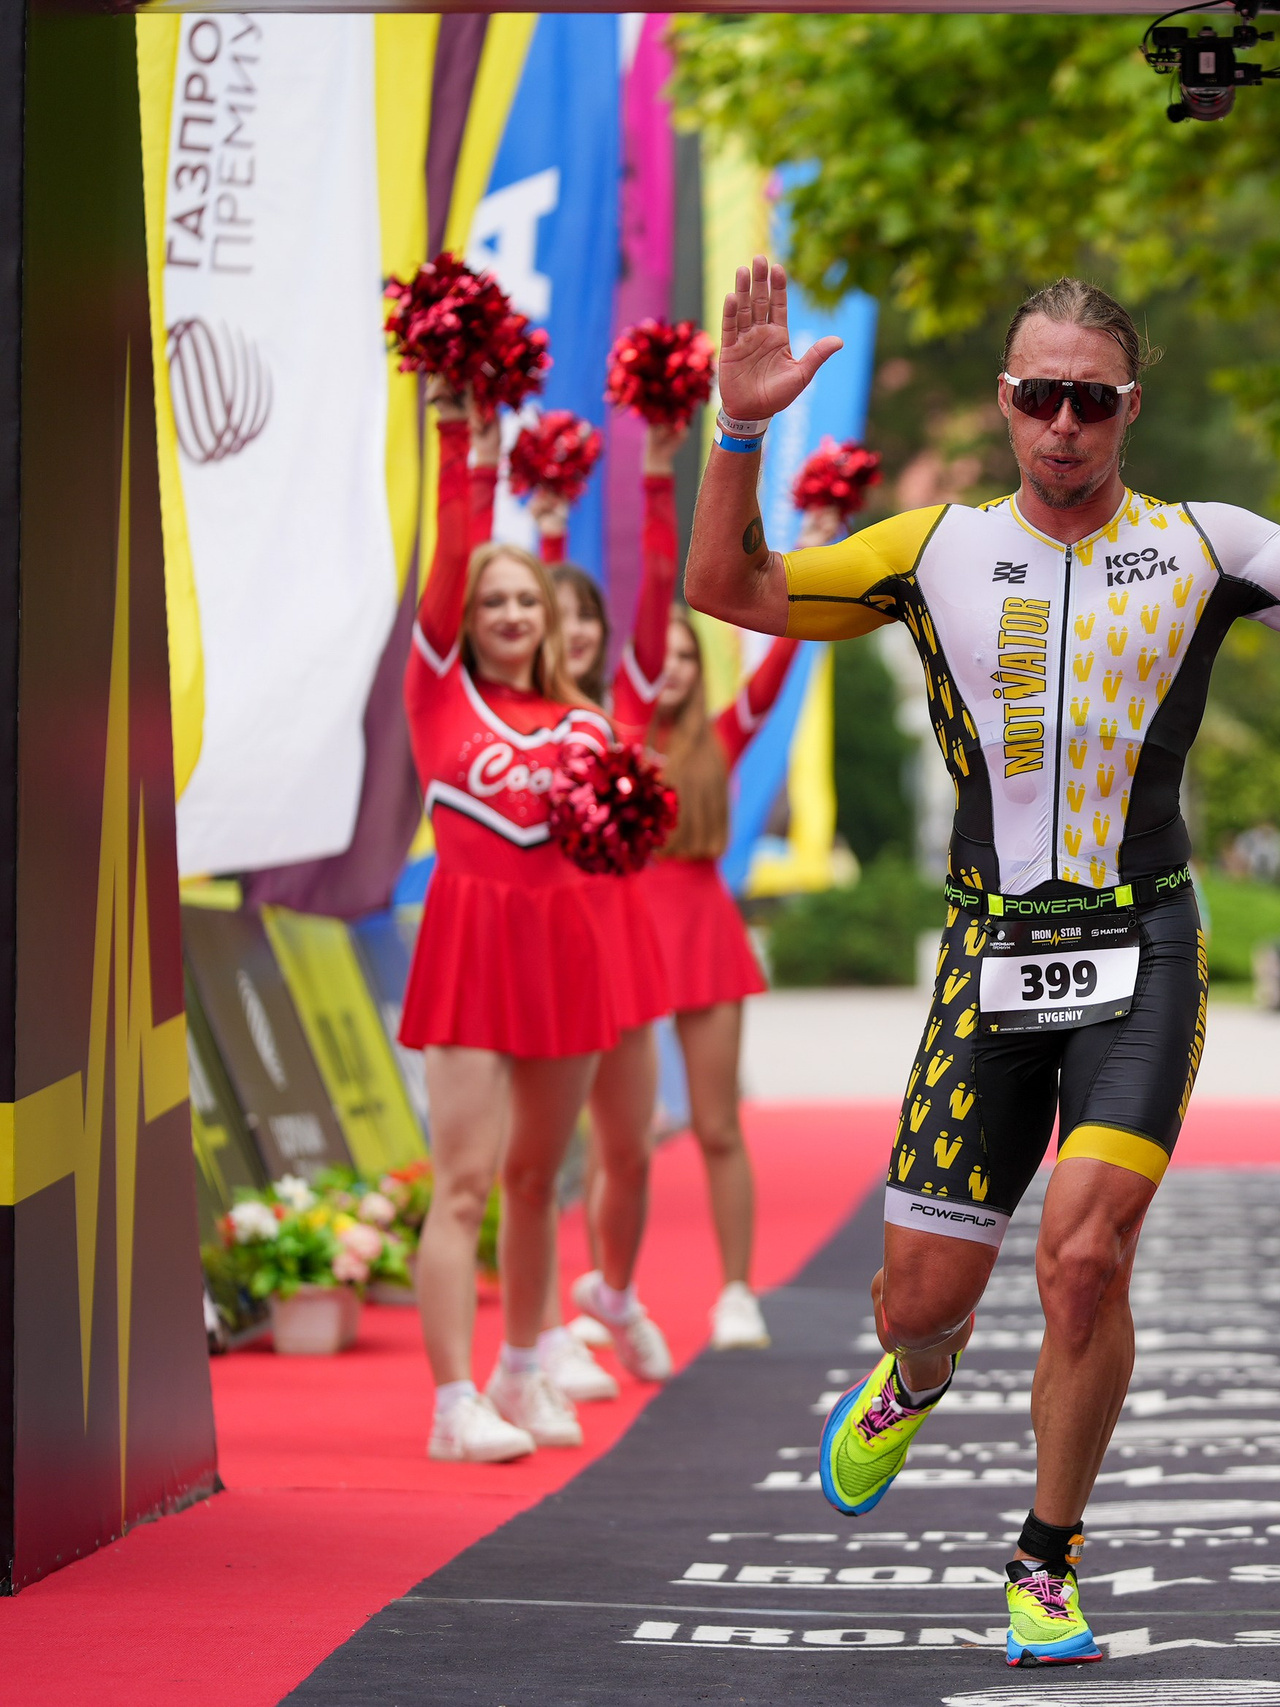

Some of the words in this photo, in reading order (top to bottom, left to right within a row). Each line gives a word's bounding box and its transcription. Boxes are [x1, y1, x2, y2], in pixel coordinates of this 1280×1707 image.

[1105, 547, 1159, 570] KOO
[1107, 555, 1180, 587] KASK
[467, 741, 554, 798] Coo
[1005, 892, 1115, 915] POWERUP
[1031, 929, 1052, 941] IRON
[1060, 926, 1082, 939] STAR
[1100, 927, 1129, 936] МАГНИТ
[1020, 959, 1098, 1001] 399
[1037, 1009, 1084, 1024] EVGENIY
[910, 1202, 997, 1228] POWERUP
[682, 1561, 1008, 1584] IRON
[633, 1620, 1010, 1645] IRON
